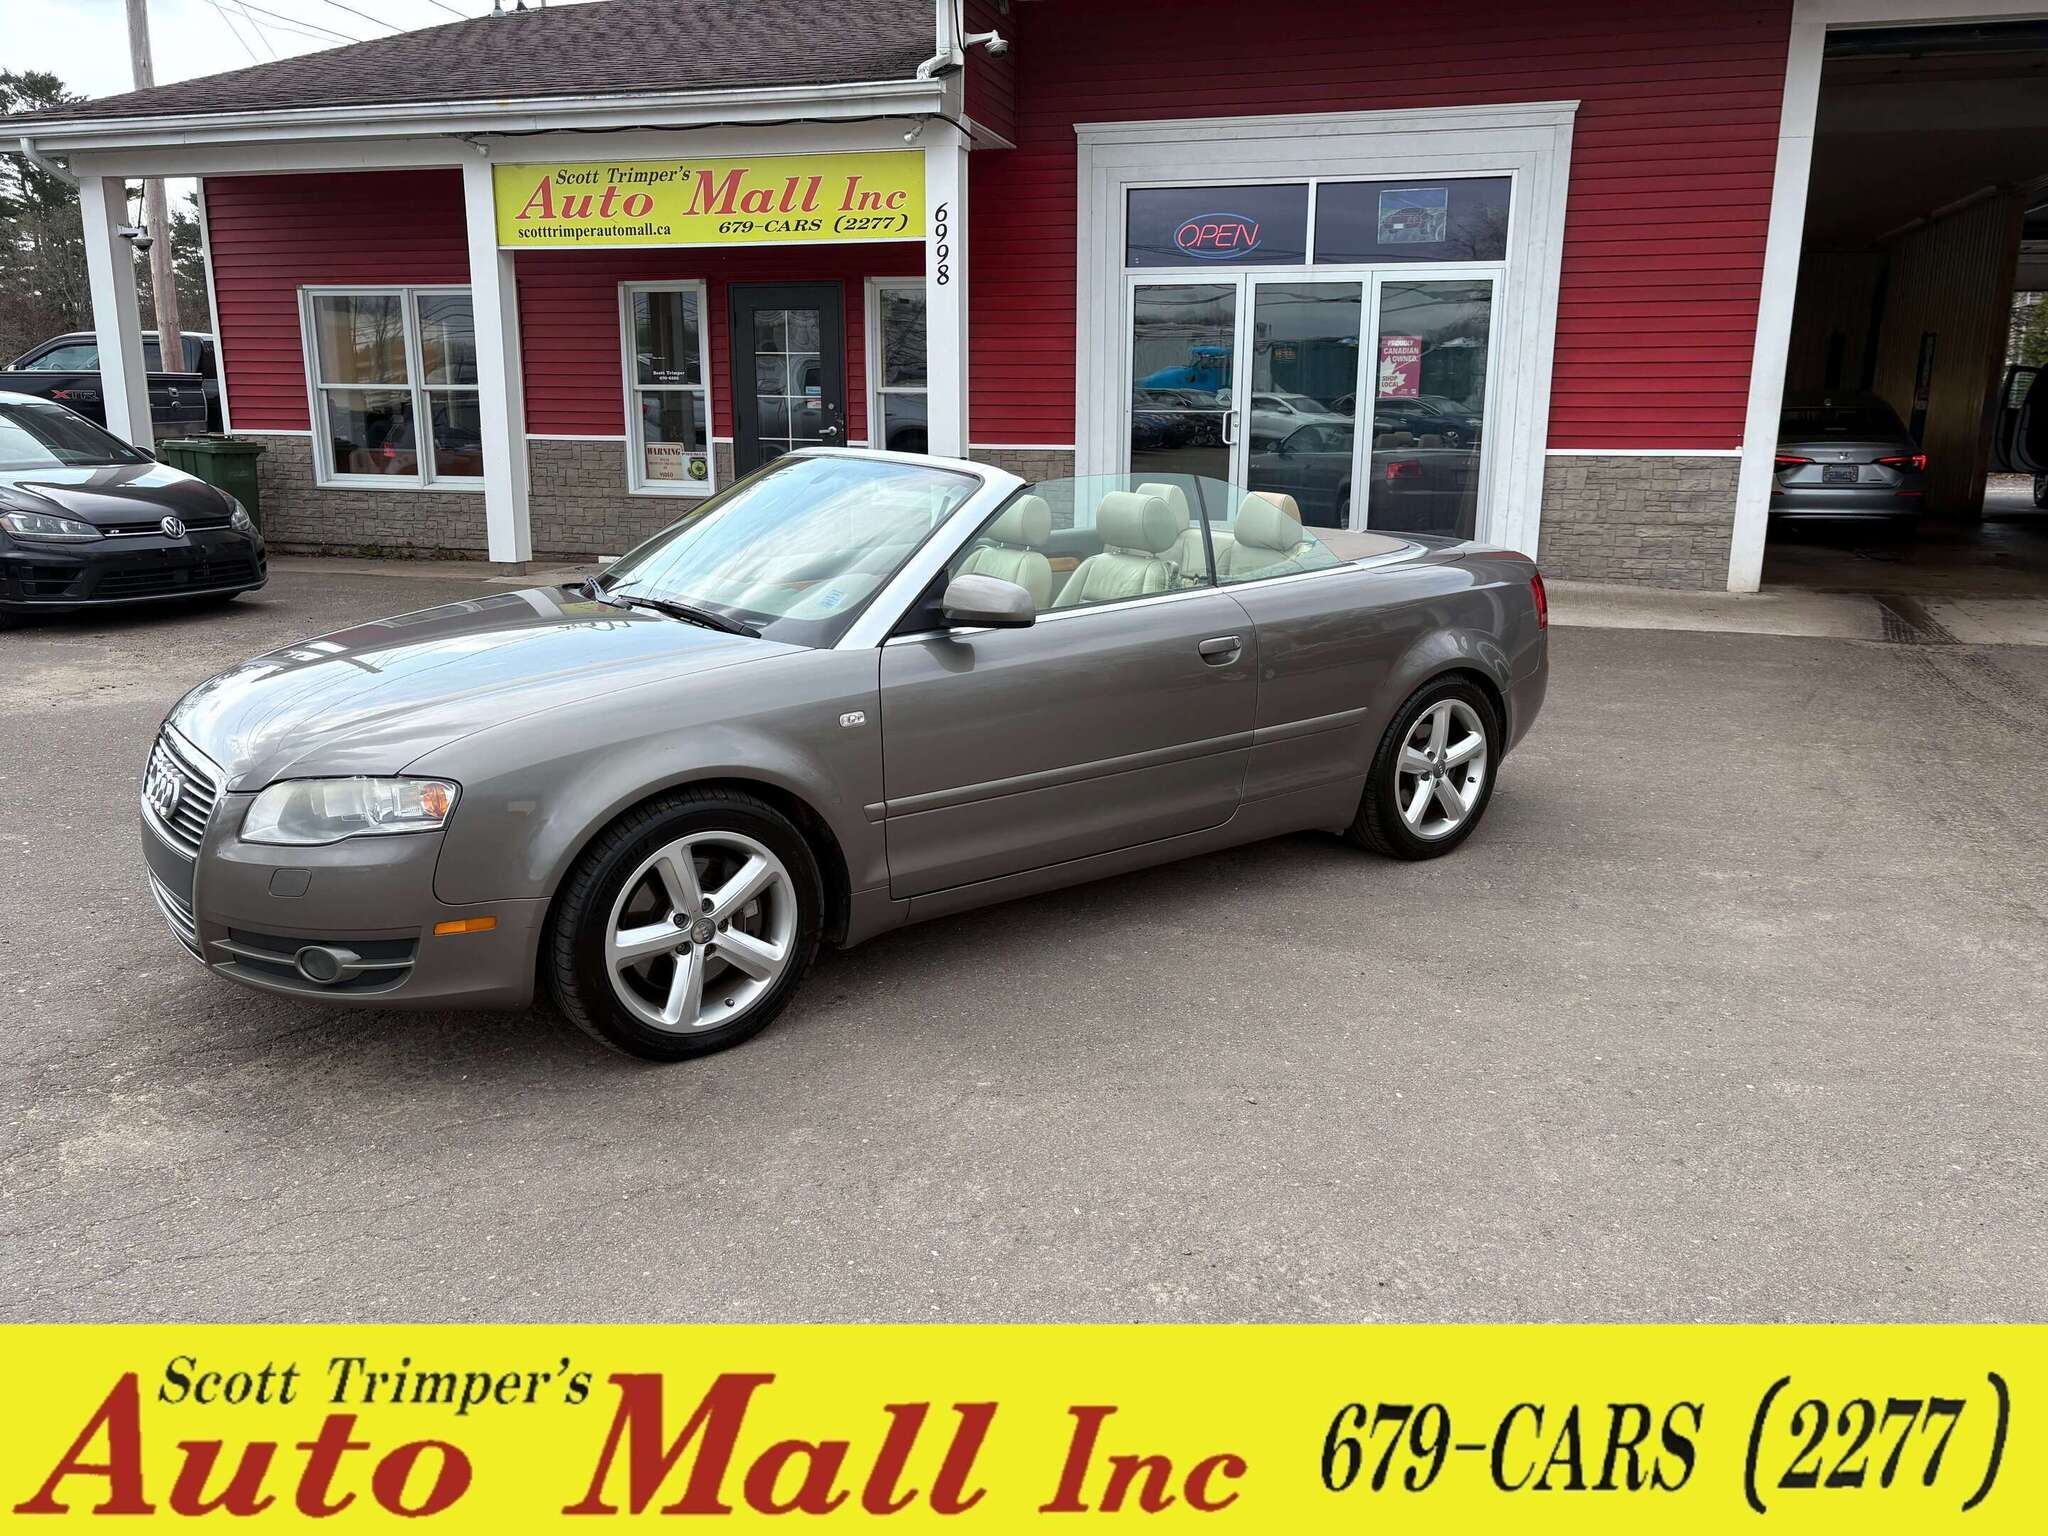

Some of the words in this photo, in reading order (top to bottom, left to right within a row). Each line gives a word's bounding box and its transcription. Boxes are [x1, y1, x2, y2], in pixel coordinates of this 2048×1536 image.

[556, 168, 598, 186] Scott
[607, 165, 690, 186] Trimper's
[516, 175, 655, 221] Auto
[683, 168, 823, 216] Mall
[837, 175, 908, 212] Inc
[518, 222, 671, 240] scotttrimperautomall.ca
[718, 218, 822, 234] 679-CARS
[833, 213, 909, 234] (2277)
[935, 202, 950, 286] 6998
[1178, 224, 1260, 246] OPEN
